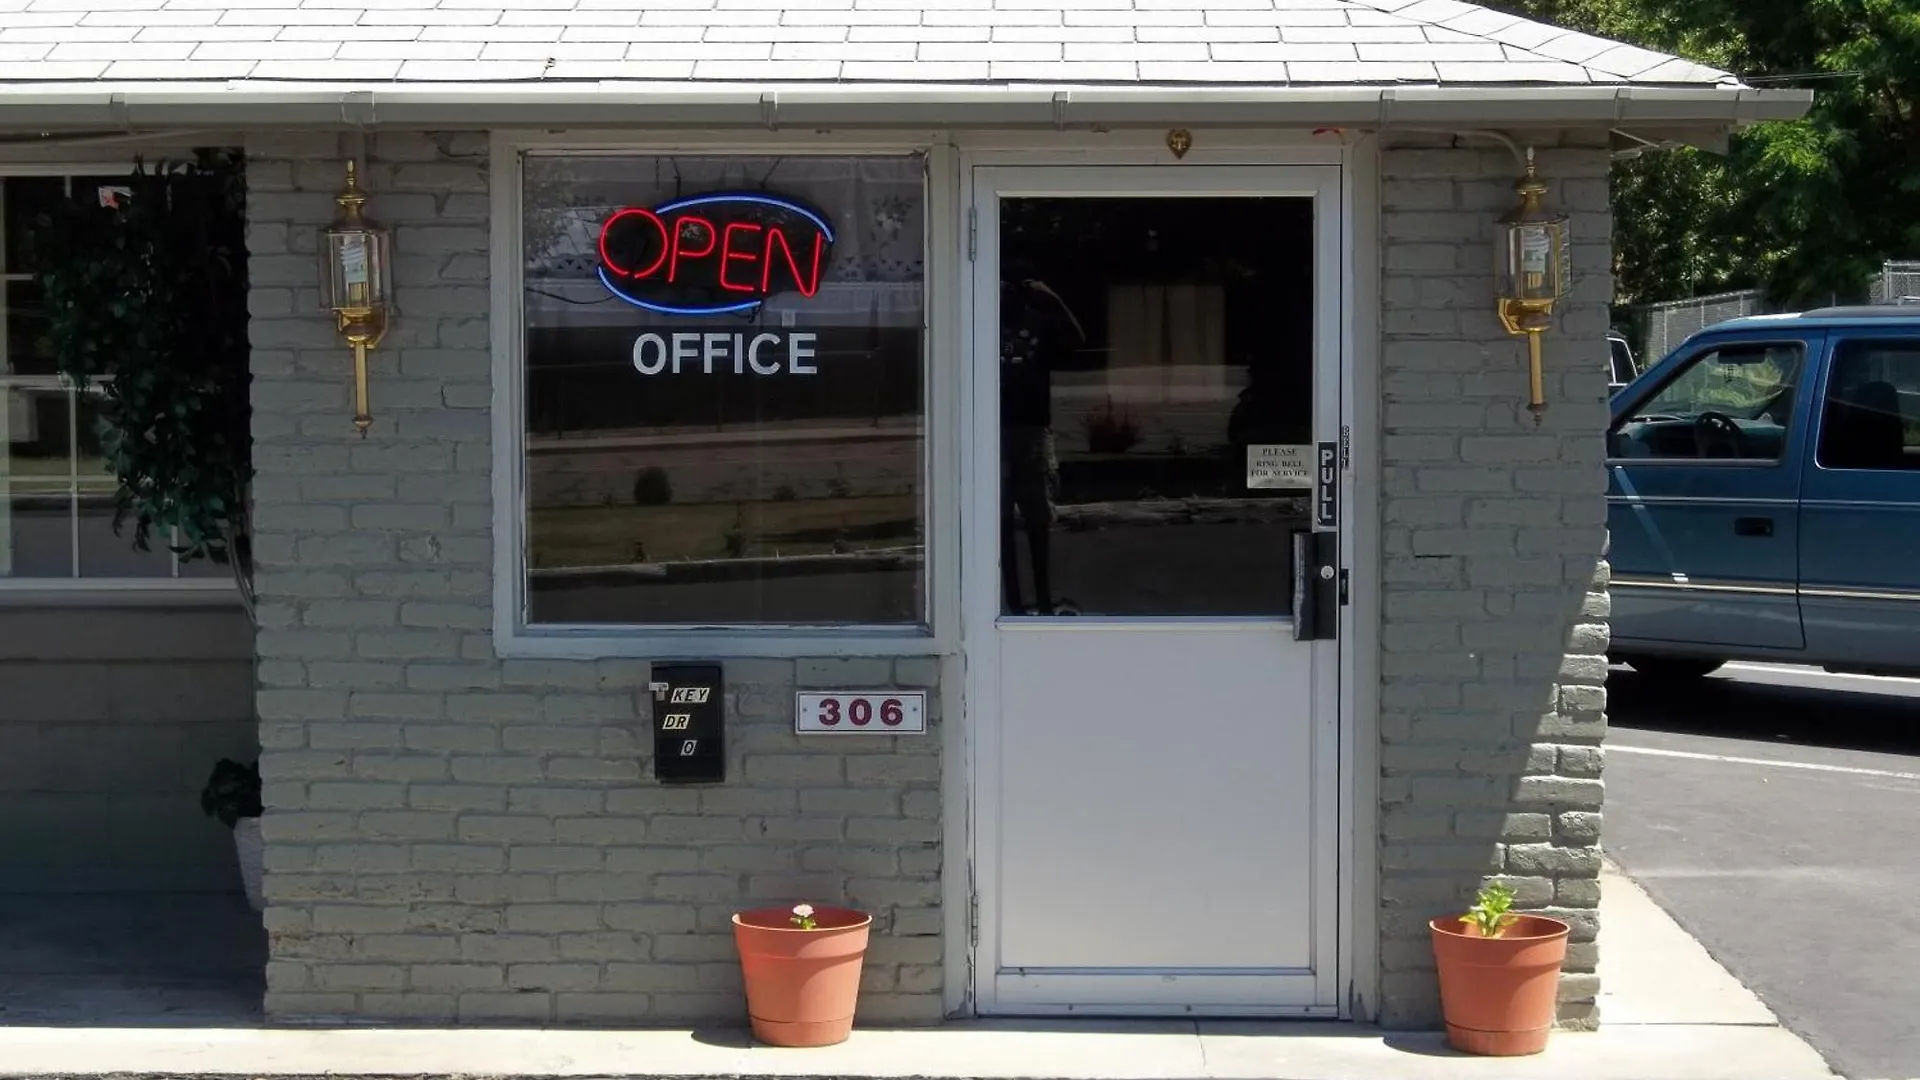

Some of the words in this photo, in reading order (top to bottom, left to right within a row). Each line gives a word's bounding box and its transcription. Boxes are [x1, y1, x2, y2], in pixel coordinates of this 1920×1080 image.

[599, 208, 823, 298] OPEN
[633, 333, 817, 375] OFFICE
[1262, 448, 1297, 456] PLEASE
[1321, 449, 1334, 519] PULL
[673, 688, 708, 702] KEY
[665, 715, 687, 728] DR
[818, 698, 904, 726] 306
